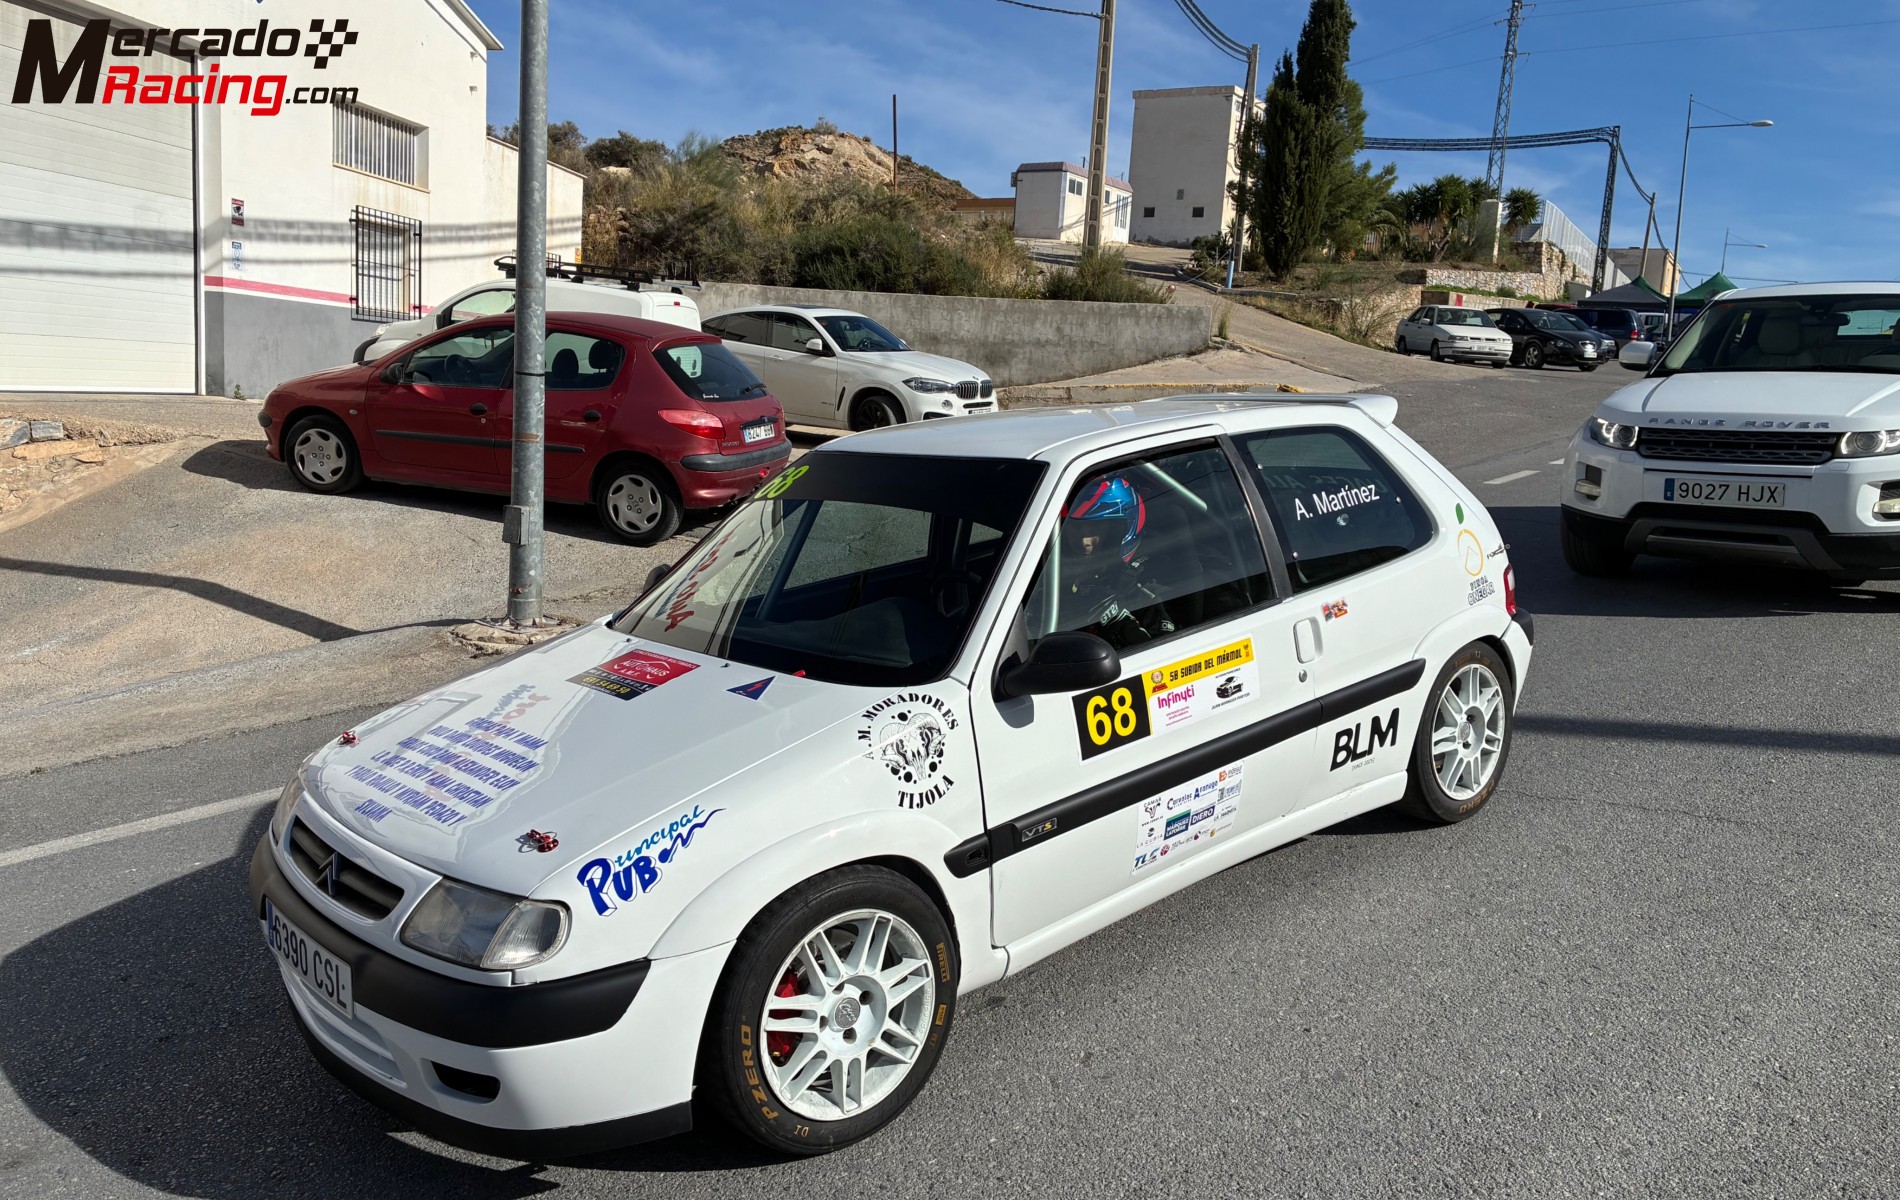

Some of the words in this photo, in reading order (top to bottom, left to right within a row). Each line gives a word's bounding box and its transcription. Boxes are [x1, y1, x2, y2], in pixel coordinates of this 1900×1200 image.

[1648, 418, 1726, 426] RANGE
[1743, 420, 1830, 429] ROVER
[754, 465, 809, 499] 68
[1678, 482, 1730, 501] 9027
[1738, 484, 1779, 504] HJX
[1294, 498, 1313, 521] A.
[1312, 484, 1380, 515] Martínez
[1181, 662, 1202, 678] SUBIDA
[1204, 658, 1214, 669] DEL
[1217, 648, 1242, 666] MÁRMOL
[861, 693, 959, 731] MORADORES
[1157, 684, 1195, 709] Infinyti
[1086, 687, 1137, 746] 68
[1329, 707, 1399, 772] BLM
[450, 757, 501, 783] ALEXANDER
[489, 775, 521, 791] ELOY
[444, 782, 494, 808] CHRISTIAN
[898, 775, 955, 809] TIJOLA
[420, 800, 460, 824] PEDAZO
[447, 815, 467, 827] Y
[1025, 821, 1052, 837] VTS
[1192, 807, 1214, 824] DIERO
[273, 914, 309, 976] 6390
[313, 950, 347, 1010] CSL
[936, 942, 951, 982] PIRELLI
